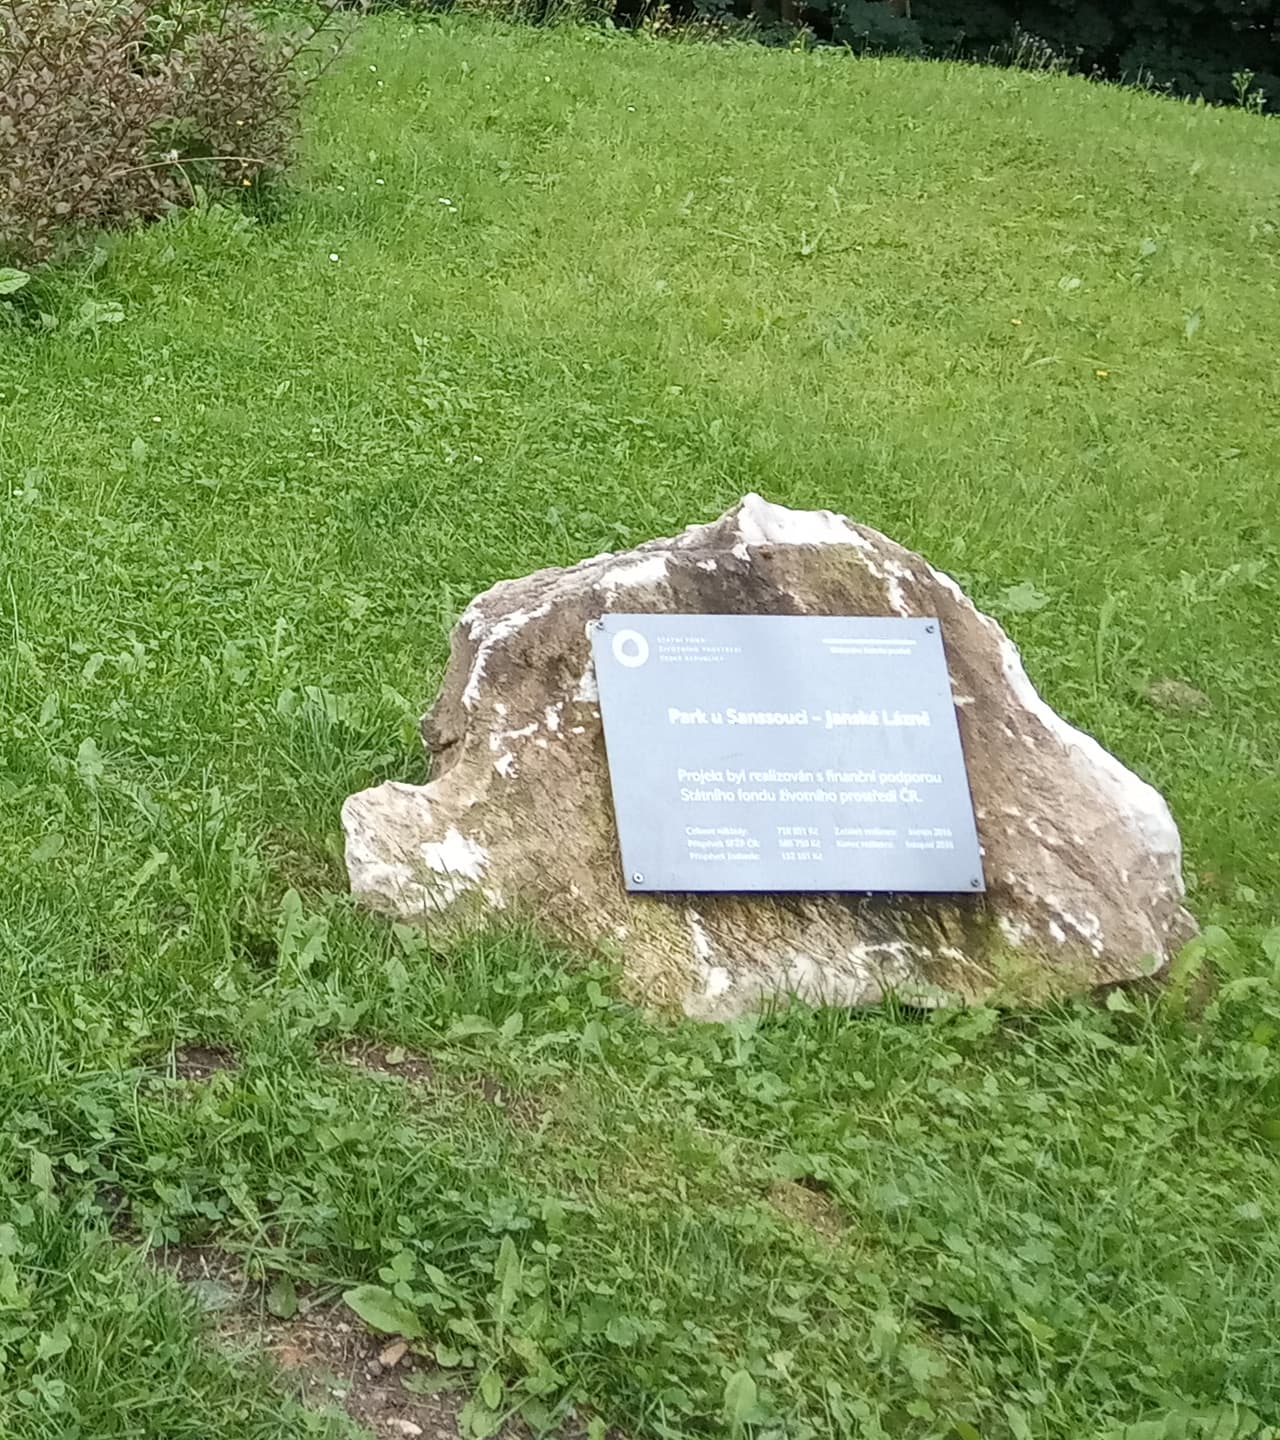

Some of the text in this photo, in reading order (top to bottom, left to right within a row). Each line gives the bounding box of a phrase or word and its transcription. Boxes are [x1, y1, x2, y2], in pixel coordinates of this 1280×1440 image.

[668, 707, 708, 725] Park
[711, 711, 723, 725] u
[727, 768, 746, 785] byl
[879, 770, 942, 786] podporou
[737, 788, 776, 802] fondu
